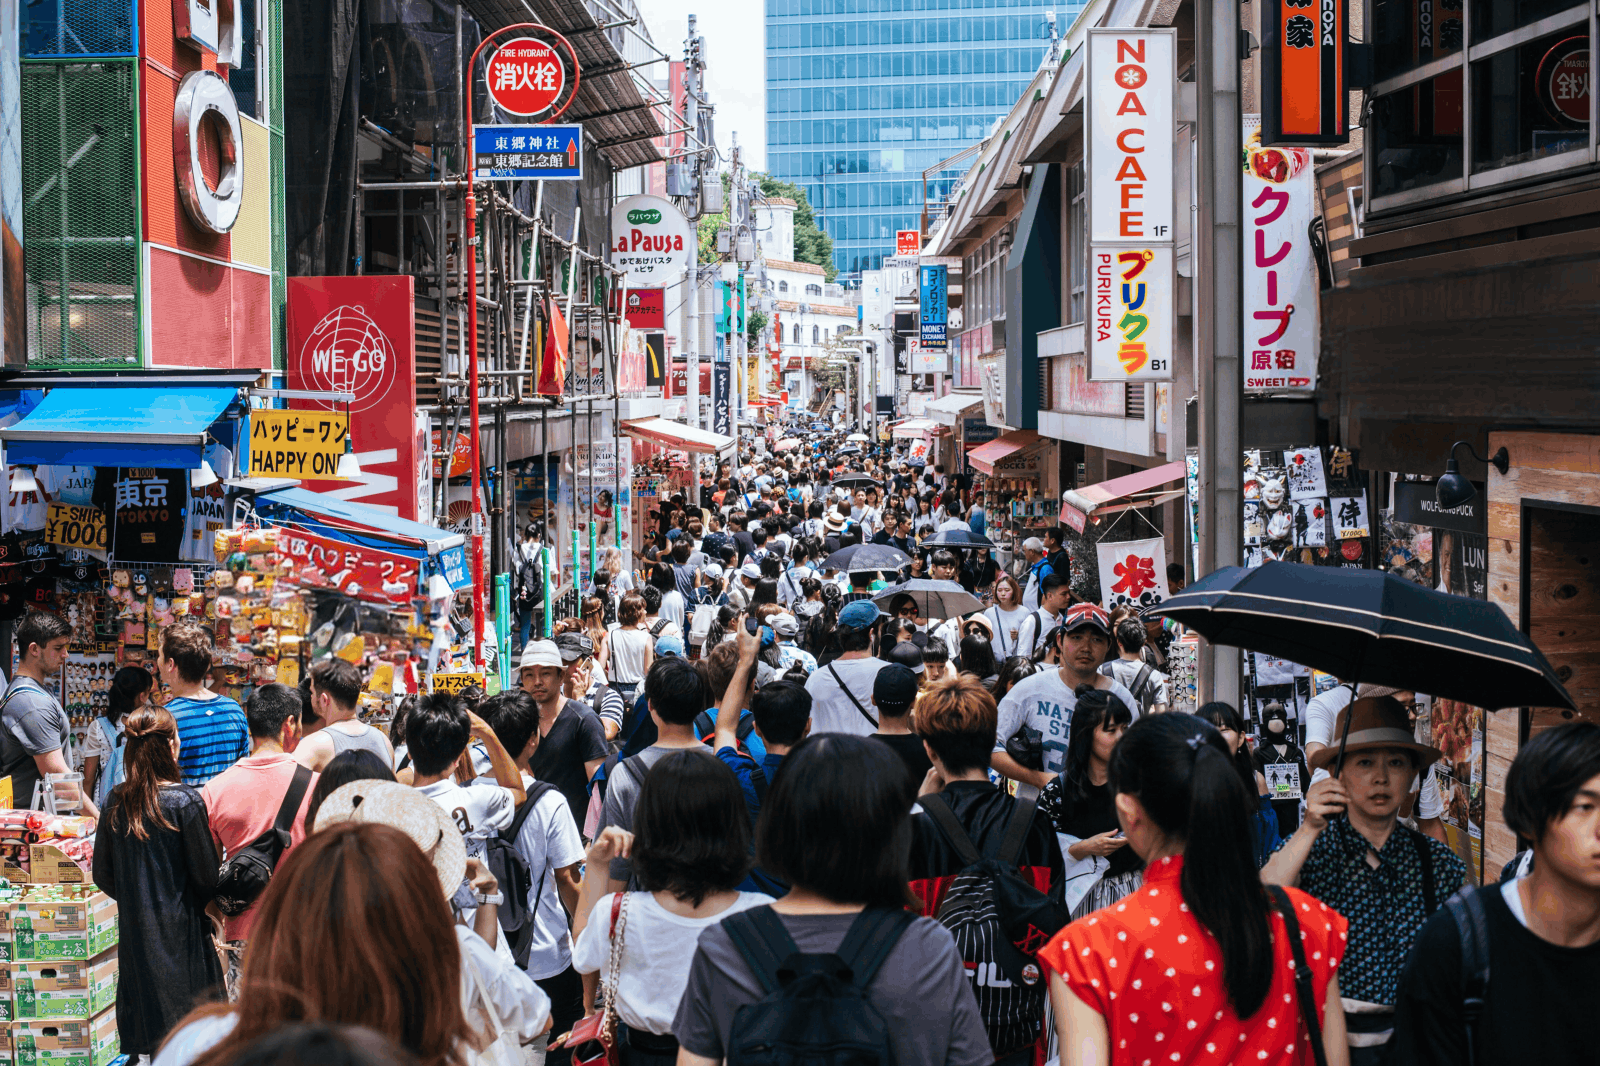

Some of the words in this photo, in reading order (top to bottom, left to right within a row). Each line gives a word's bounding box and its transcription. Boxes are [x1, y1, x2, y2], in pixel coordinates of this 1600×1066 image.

[500, 49, 516, 58] FIRE
[518, 49, 551, 58] HYDRANT
[494, 62, 558, 91] 消火栓
[1114, 39, 1148, 116] NOA
[495, 136, 560, 150] 東郷神社
[494, 154, 563, 168] 東郷記念館
[1115, 128, 1148, 237] CAFE
[631, 228, 683, 254] Pausa
[1153, 225, 1168, 237] 1F
[1251, 185, 1295, 347] クレープ
[1097, 253, 1111, 342] PURIKURA
[1117, 250, 1153, 375] プリクラ
[921, 325, 946, 333] MONEY
[1152, 360, 1167, 371] B1
[1247, 378, 1285, 387] SWEET
[253, 417, 347, 442] ハッピーワン
[252, 450, 307, 473] HAPPY
[1000, 462, 1026, 470] SOCKS
[113, 476, 169, 509] 東京
[117, 509, 169, 524] TOKYO
[192, 500, 225, 519] JAPAN
[1338, 498, 1361, 528] 侍
